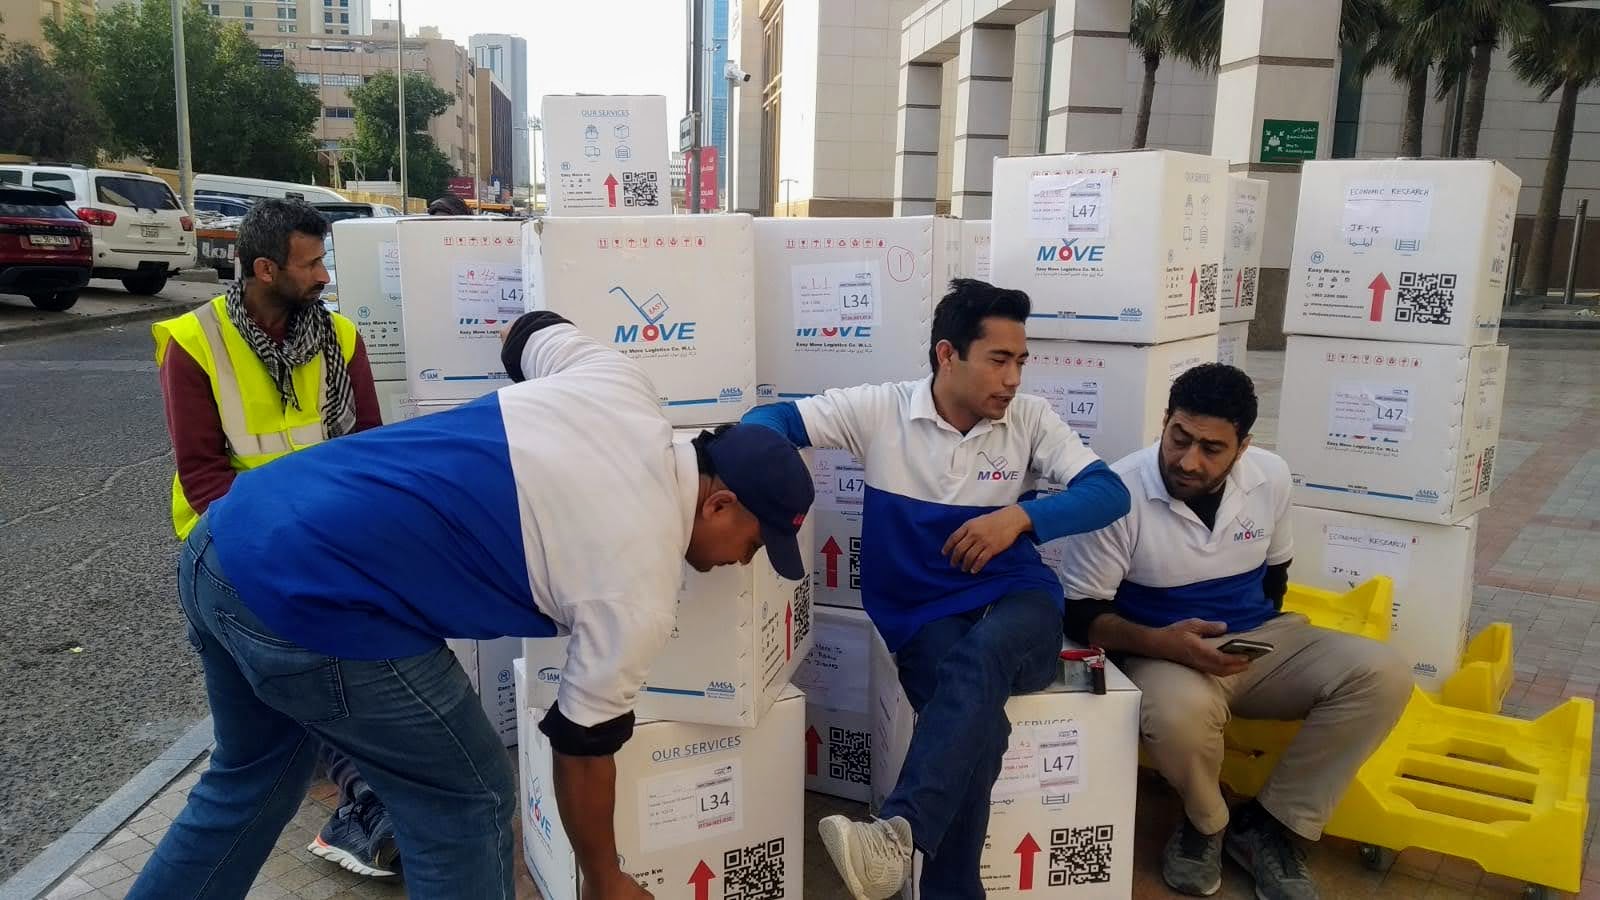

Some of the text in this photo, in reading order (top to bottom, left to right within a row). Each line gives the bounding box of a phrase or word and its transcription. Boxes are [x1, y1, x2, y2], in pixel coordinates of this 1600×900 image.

[1072, 205, 1097, 218] L47
[1036, 245, 1106, 261] MOVE
[501, 288, 524, 302] L47
[843, 294, 870, 308] L34
[648, 301, 663, 315] EASY
[614, 322, 697, 343] MOVE
[1070, 402, 1094, 415] L47
[1377, 407, 1404, 421] L47
[977, 470, 1019, 481] MOVE
[838, 479, 864, 493] L47
[1233, 528, 1265, 542] MOVE
[708, 680, 733, 690] AMSA
[651, 735, 742, 762] OUR SERVICES
[1043, 754, 1074, 773] L47
[700, 791, 730, 813] L34
